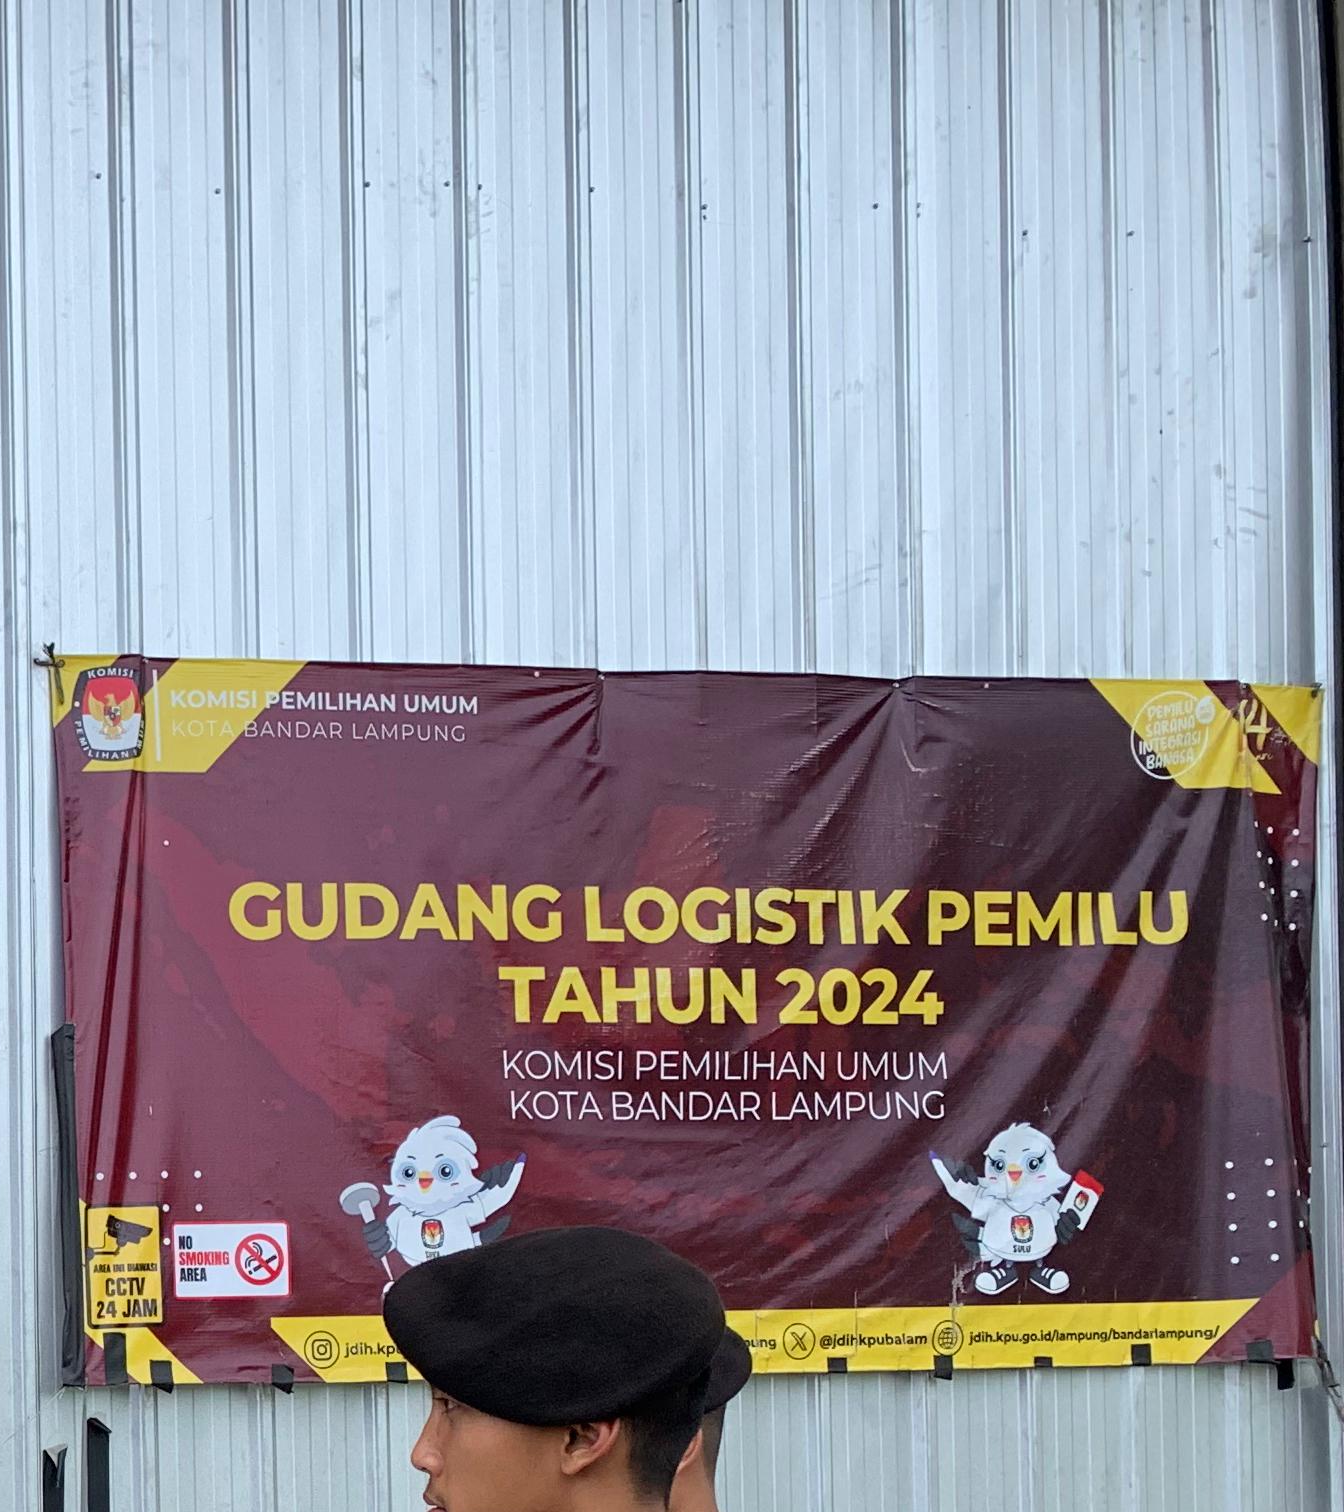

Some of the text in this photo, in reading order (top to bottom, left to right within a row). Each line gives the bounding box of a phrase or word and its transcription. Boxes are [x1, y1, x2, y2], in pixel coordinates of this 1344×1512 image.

[88, 668, 133, 679] KOMISI
[170, 690, 478, 714] KOMISI PEMILIHAN UMUM
[1147, 701, 1193, 721] PEMILU
[172, 720, 466, 742] KOTA BANDAR LAMPUNG
[1146, 715, 1196, 737] SARANA
[1139, 731, 1201, 755] INTEGRASI
[1146, 748, 1194, 769] BANGSA
[228, 881, 1189, 947] GUDANG LOGISTIK PEMILU
[498, 966, 944, 1026] TAHUN 2024
[503, 1050, 948, 1081] KOMISI PEMILIHAN UMUM
[511, 1091, 946, 1121] KOTA BANDAR LAMPUNG
[178, 1235, 192, 1250] NO
[93, 1264, 111, 1273] AREA
[179, 1252, 230, 1266] SMOKING
[180, 1268, 207, 1282] AREA
[105, 1277, 145, 1297] CCTV
[96, 1299, 158, 1319] 24 JAM
[819, 1333, 928, 1350] @jdihkpubalam
[968, 1325, 1220, 1345] jdih.kpu.go.id/lampung/bandarlampung/
